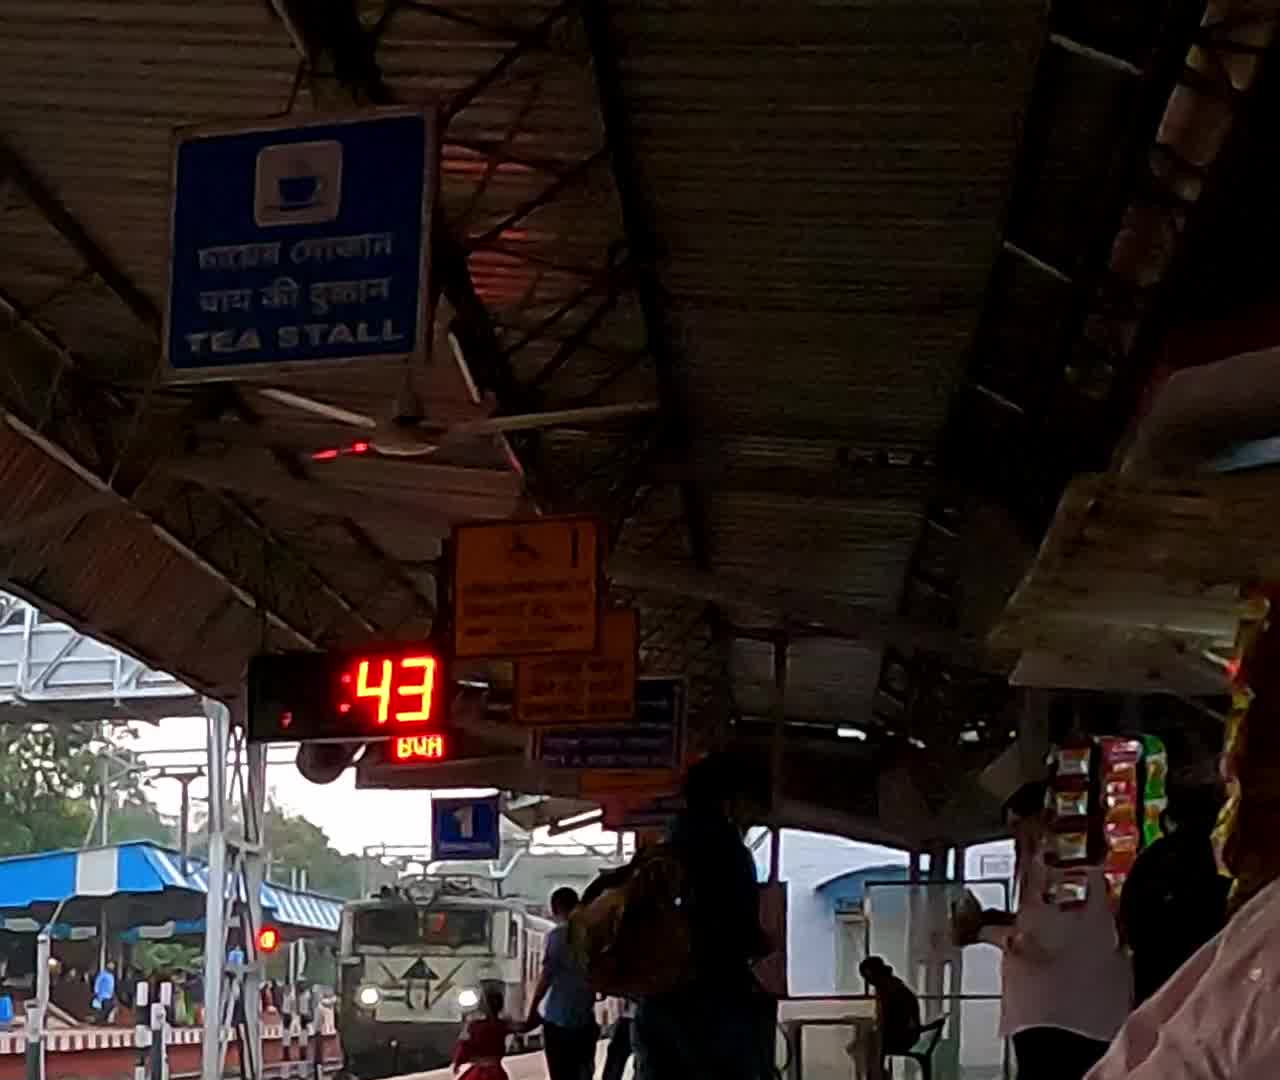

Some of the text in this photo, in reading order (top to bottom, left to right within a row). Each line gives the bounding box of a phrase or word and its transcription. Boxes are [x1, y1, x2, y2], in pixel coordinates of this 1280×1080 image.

[259, 275, 301, 311] की
[184, 317, 405, 354] TEA STALL
